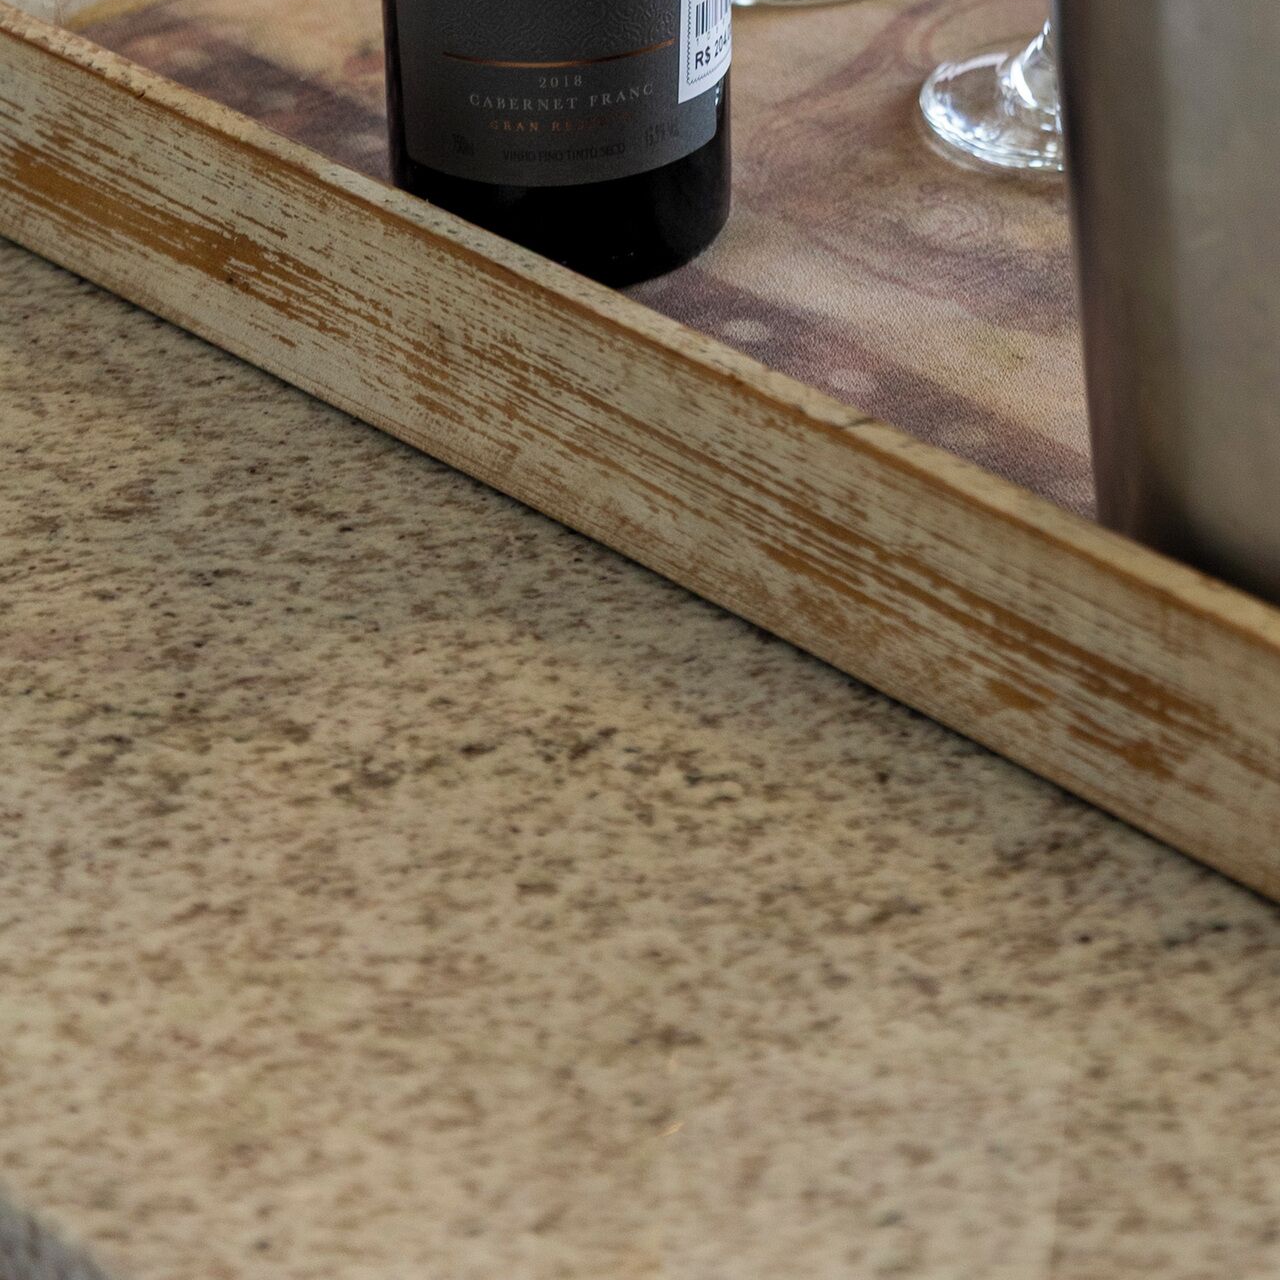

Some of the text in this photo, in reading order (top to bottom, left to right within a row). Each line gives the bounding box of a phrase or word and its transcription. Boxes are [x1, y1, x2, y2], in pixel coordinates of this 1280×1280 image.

[694, 45, 711, 70] R$
[539, 75, 583, 89] 2018
[469, 83, 654, 111] CABERNET FRANC
